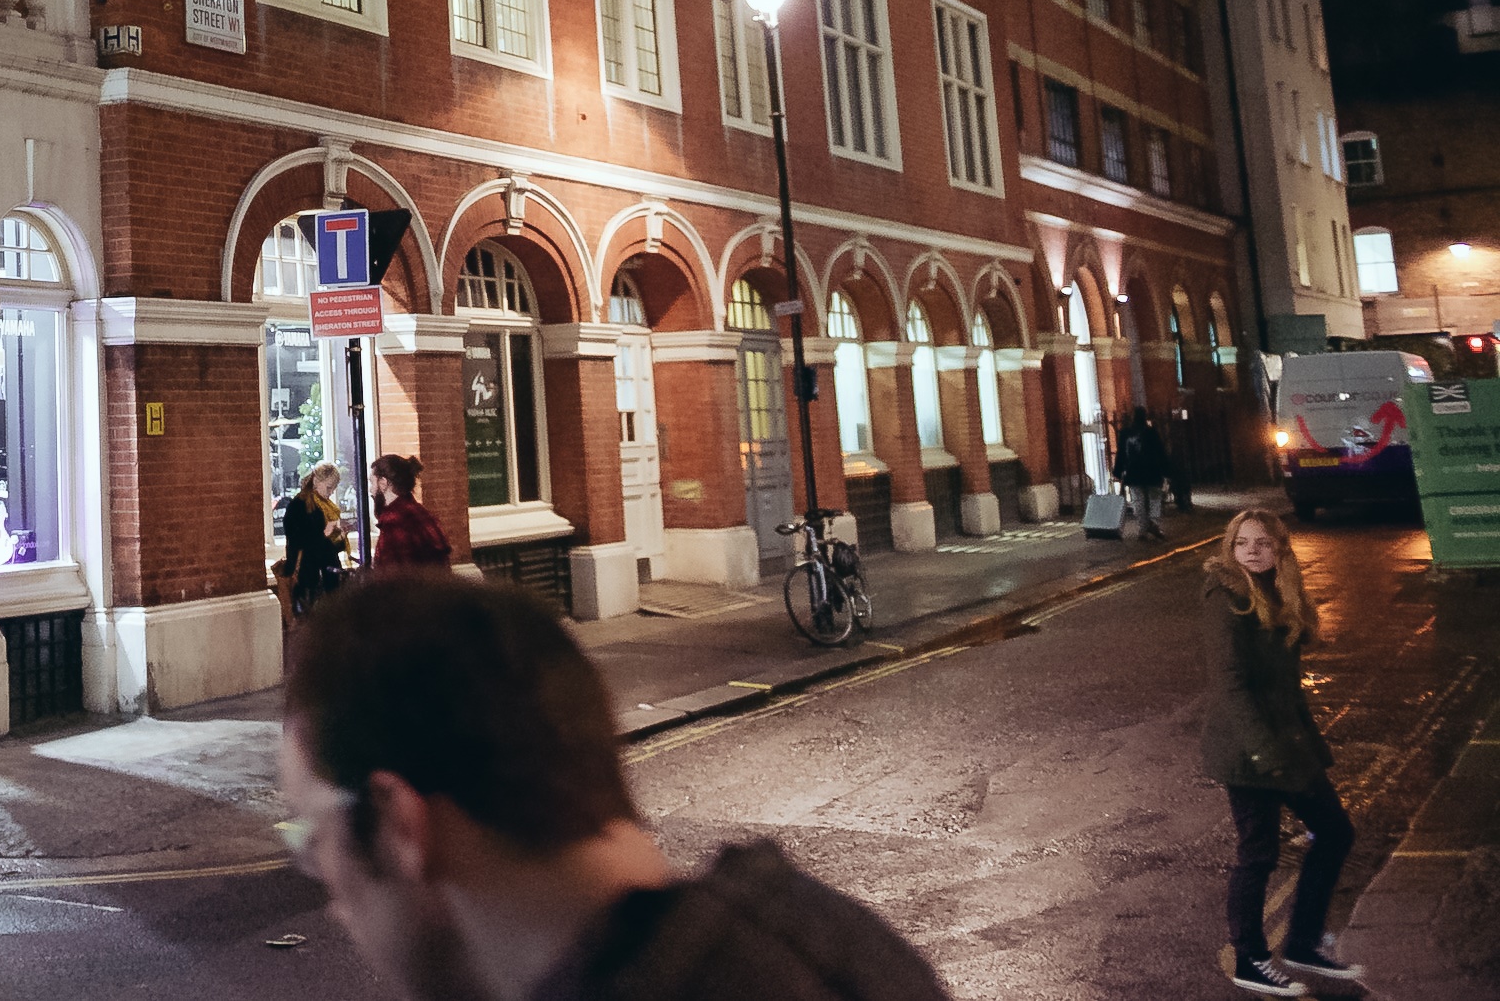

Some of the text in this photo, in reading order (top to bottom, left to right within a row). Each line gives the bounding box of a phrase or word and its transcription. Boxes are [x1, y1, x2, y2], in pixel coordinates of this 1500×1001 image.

[193, 9, 240, 33] STREET W1
[329, 293, 373, 303] PEDESTRIAN
[314, 306, 379, 317] ACCESS THROUGH
[1, 319, 36, 336] YAMAHA
[314, 319, 380, 331] SHERATON STREET
[150, 406, 162, 432] H
